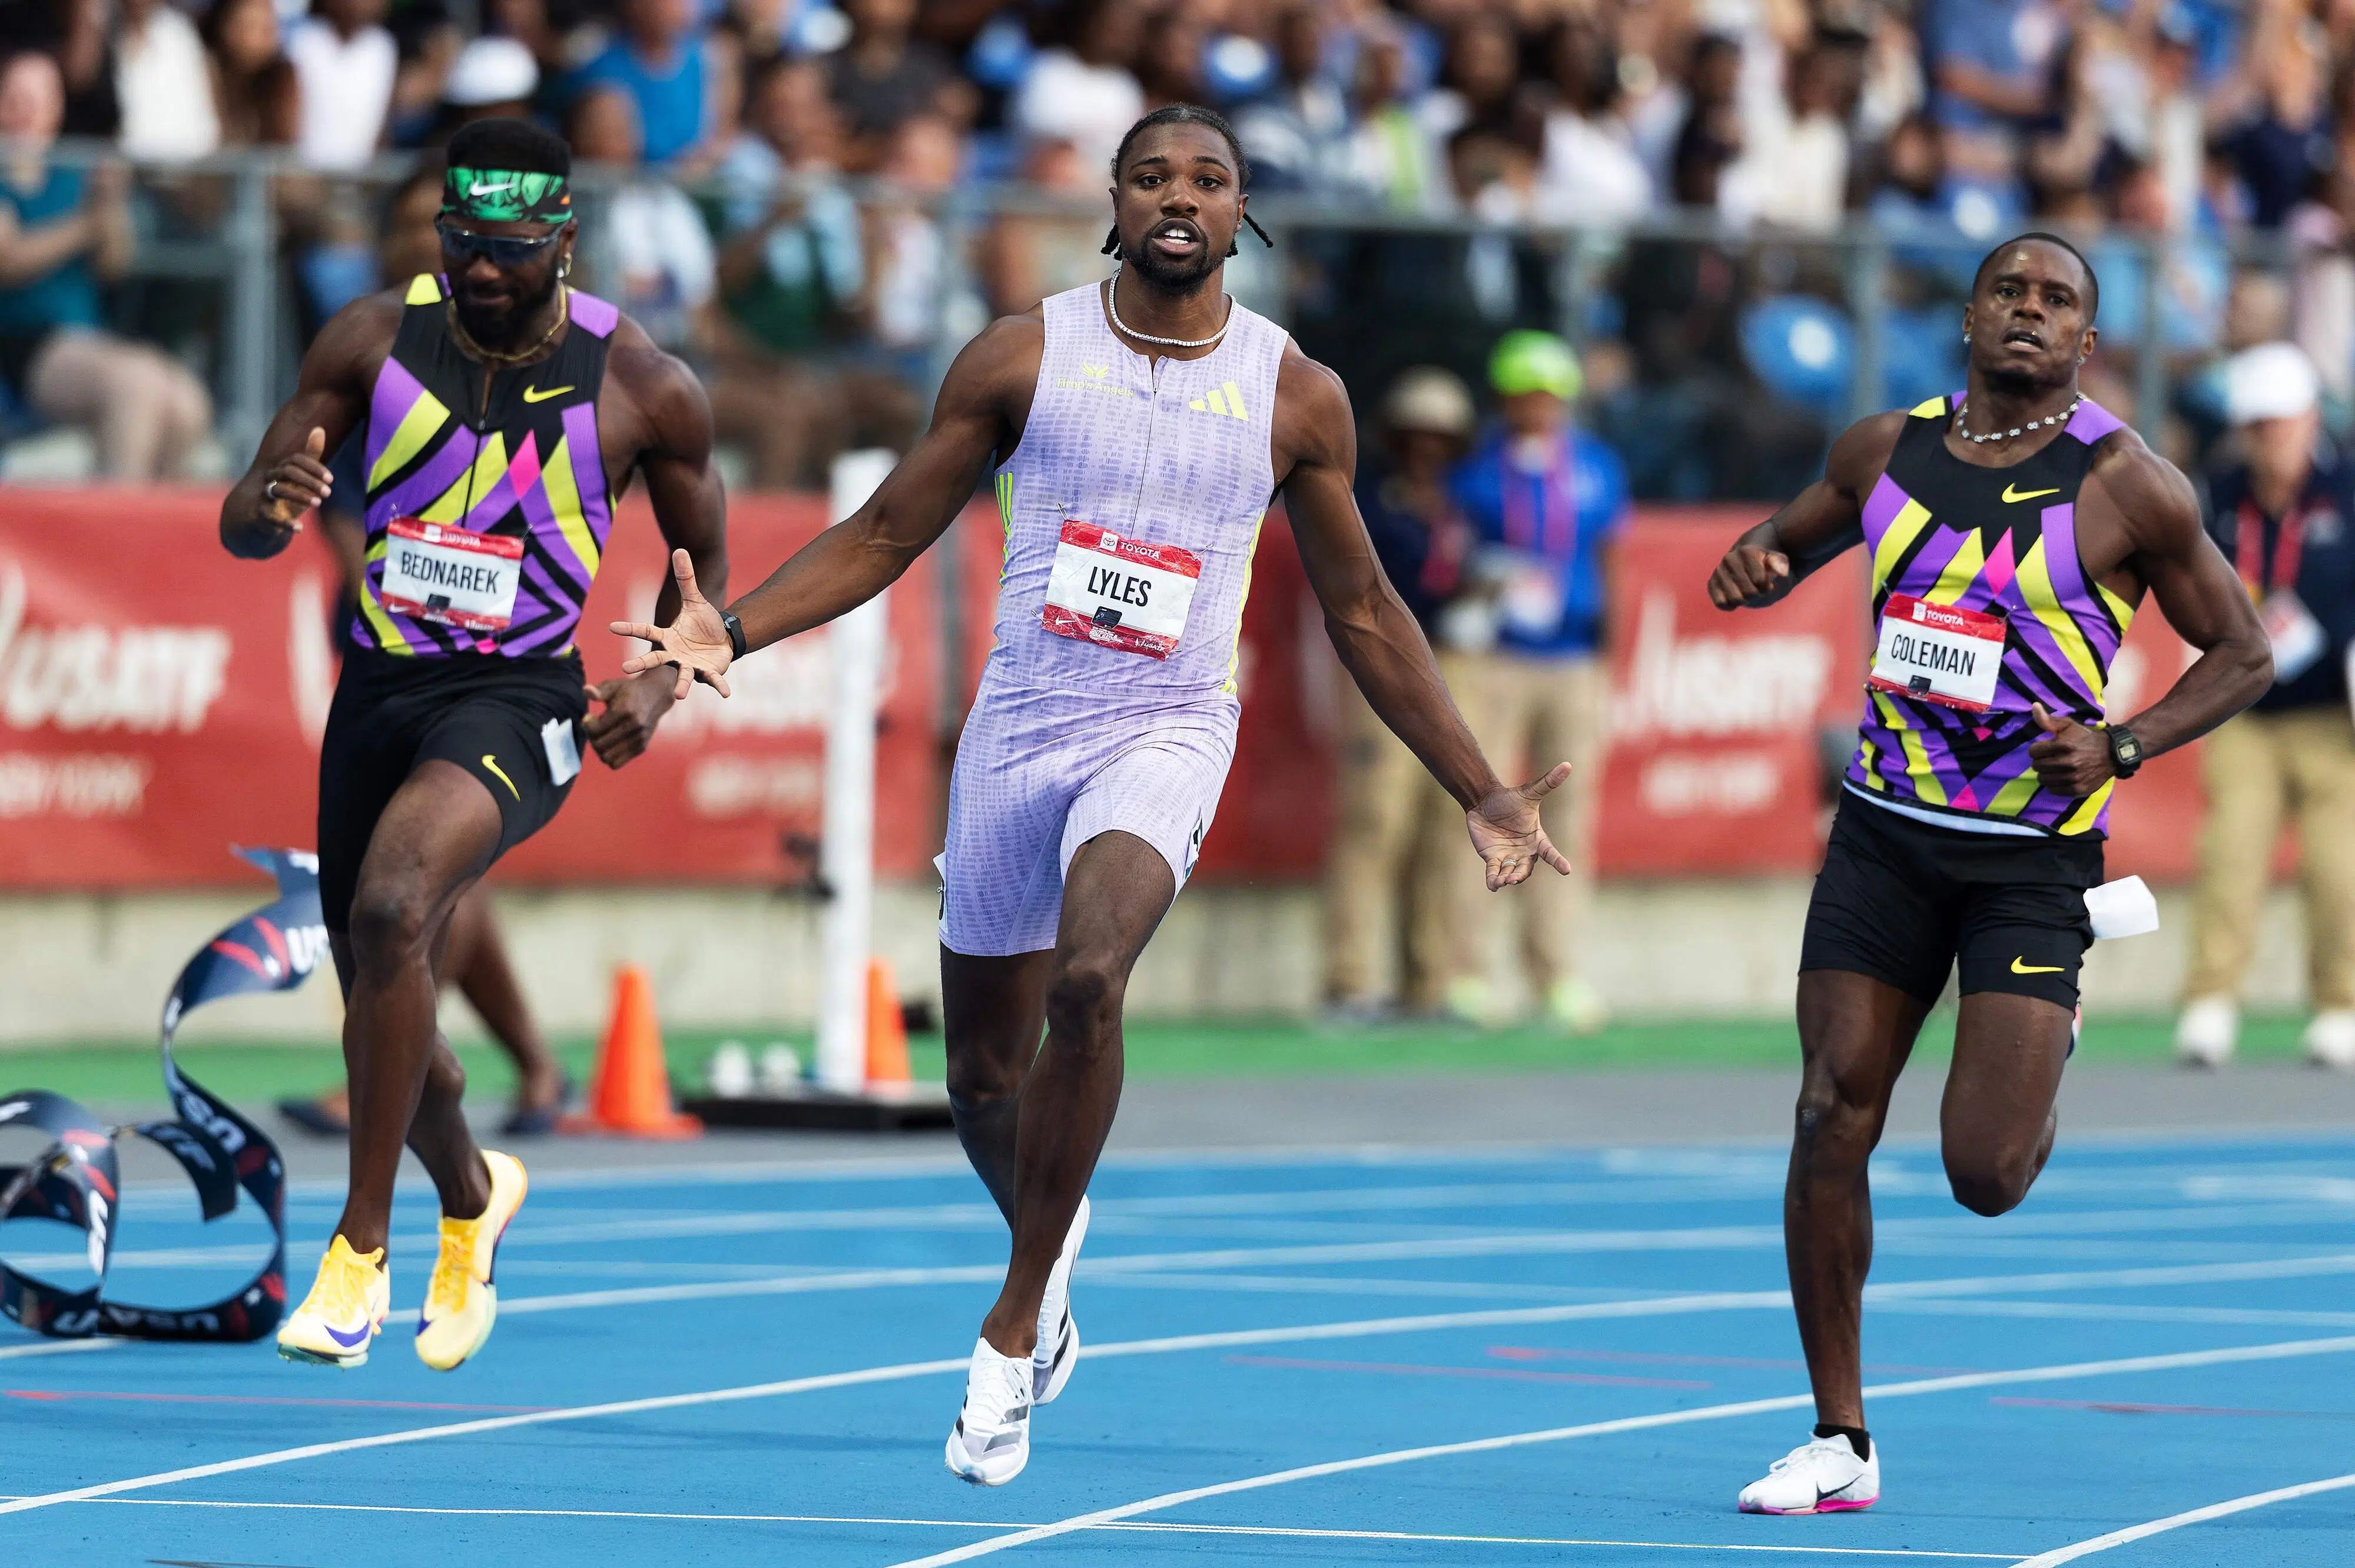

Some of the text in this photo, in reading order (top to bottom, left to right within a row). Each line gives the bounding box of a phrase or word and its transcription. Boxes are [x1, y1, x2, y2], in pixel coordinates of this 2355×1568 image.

[1095, 381, 1134, 397] Angels
[1120, 542, 1160, 559] TOYOTA
[400, 550, 500, 594] BEDNAREK
[1087, 566, 1152, 607] LYLES
[1926, 610, 1964, 626] TOYOTA
[1890, 633, 1976, 676] COLEMAN
